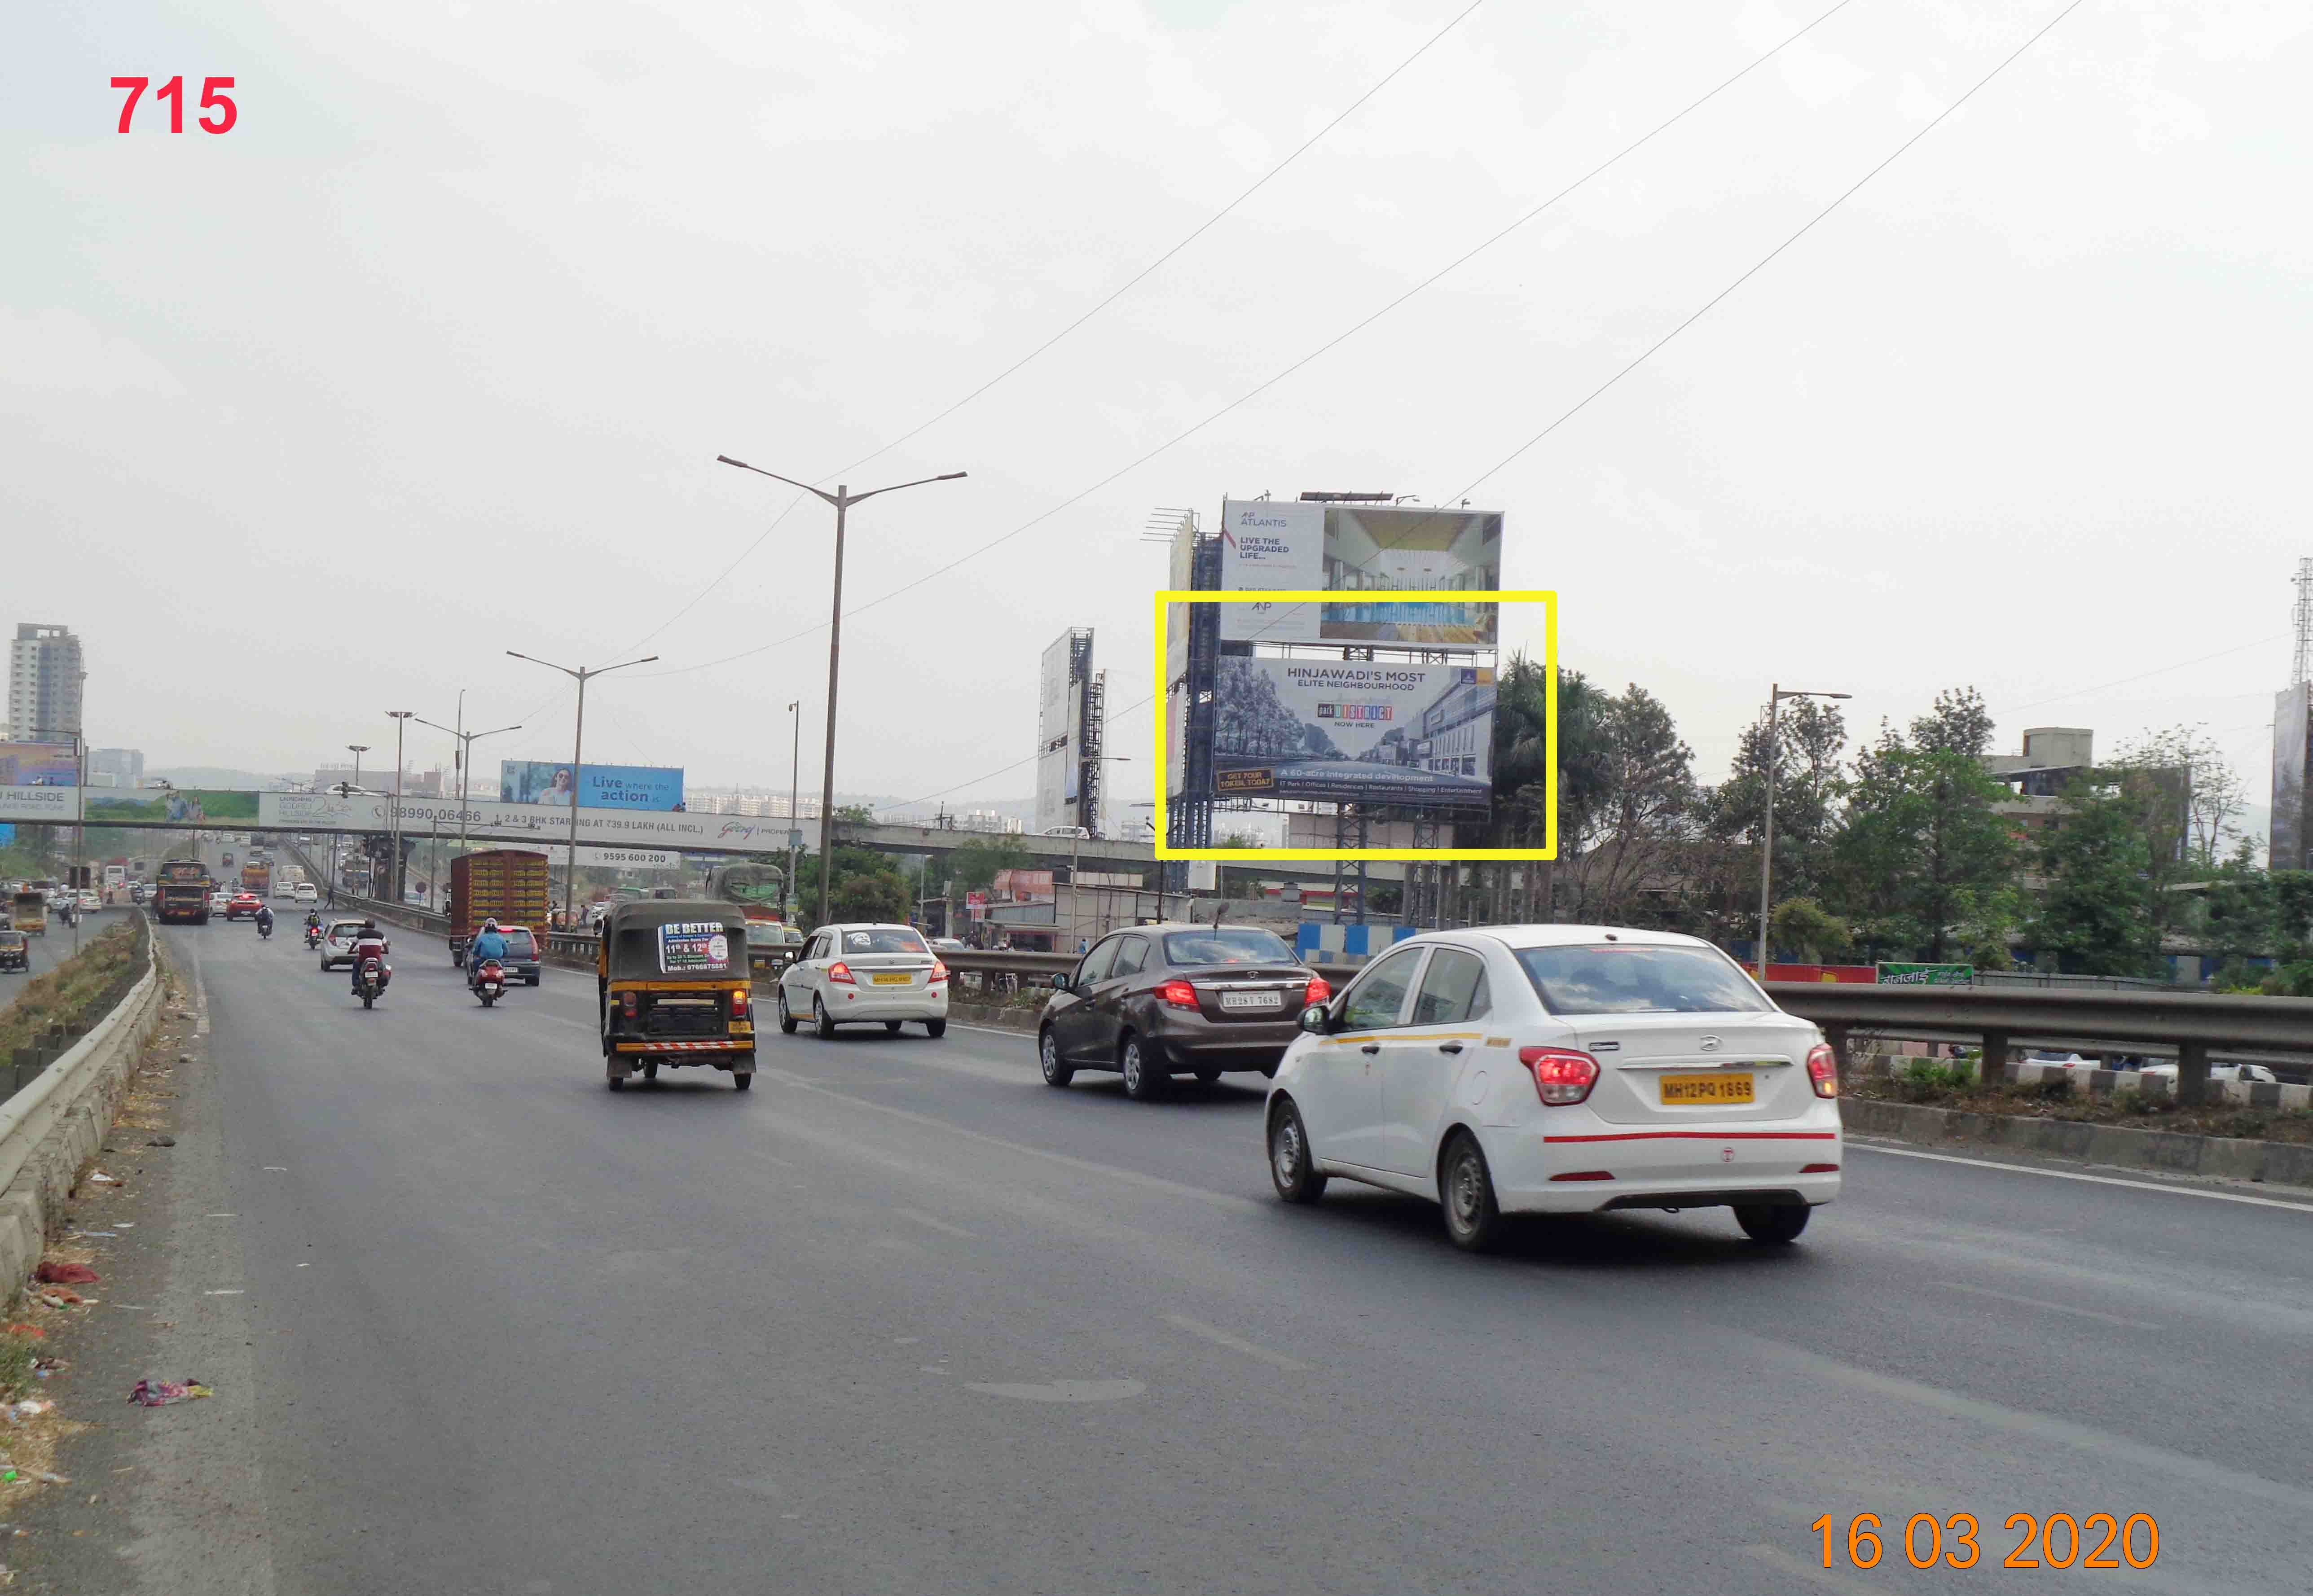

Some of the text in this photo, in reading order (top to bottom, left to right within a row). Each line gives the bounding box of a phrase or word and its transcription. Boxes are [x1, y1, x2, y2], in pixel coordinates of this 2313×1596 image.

[1241, 518, 1286, 527] ATLANTIS
[1240, 544, 1289, 552] UPGRADED
[1288, 668, 1425, 683] HINJAWADI'S MOST
[1327, 681, 1414, 691] NEIGHBOURHOOD
[1319, 705, 1333, 716] park
[593, 776, 622, 788] Live
[1325, 771, 1372, 780] integrated
[1375, 772, 1434, 782] development
[7, 791, 65, 801] HILLSIDE
[601, 790, 648, 802] action
[390, 807, 481, 822] 98990 06466
[530, 816, 546, 824] BHK
[550, 817, 590, 827] STARING
[593, 819, 603, 828] AT
[632, 822, 654, 830] LAKH
[657, 822, 675, 833] (ALL
[678, 824, 704, 834] INCL.)
[603, 853, 665, 863] 9595 600 200
[682, 922, 724, 934] BETTER
[666, 944, 681, 953] 11th
[683, 944, 690, 952] &
[692, 943, 707, 952] 12th
